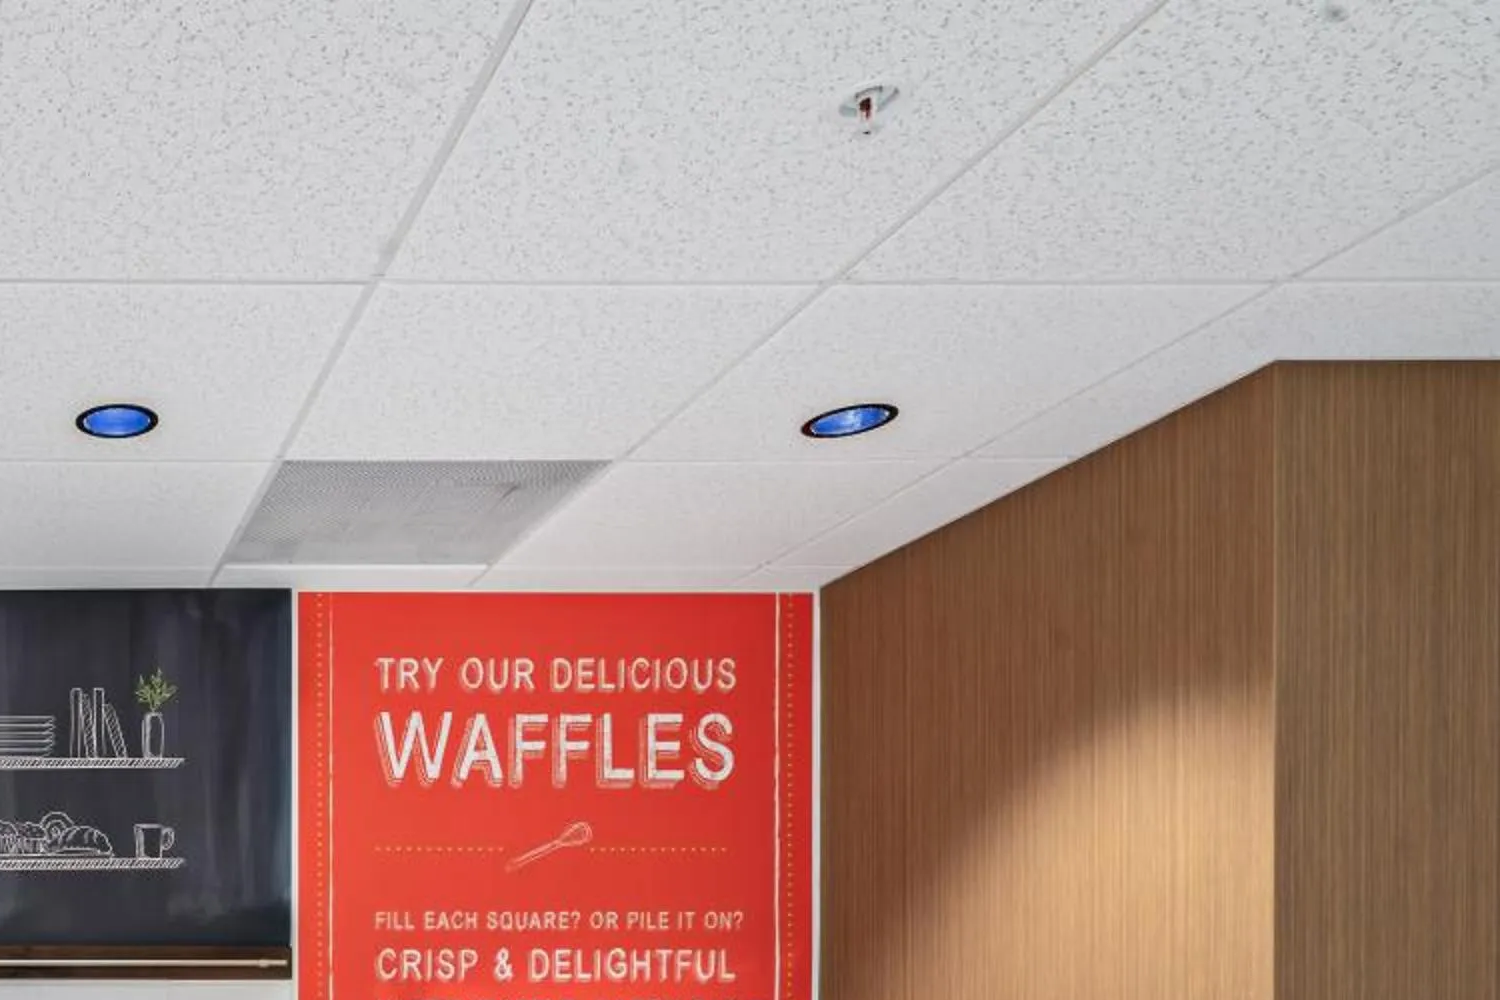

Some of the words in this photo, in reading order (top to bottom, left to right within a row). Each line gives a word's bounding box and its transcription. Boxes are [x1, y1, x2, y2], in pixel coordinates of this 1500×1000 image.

[374, 657, 444, 693] TRY
[459, 657, 535, 693] OUR
[551, 657, 737, 693] DELICIOUS
[374, 711, 736, 789] WAFFLES
[375, 911, 415, 930] FILL
[424, 911, 478, 930] EACH
[486, 911, 581, 931] SQUARE?
[590, 911, 619, 930] OR
[626, 911, 669, 930] PILE
[677, 911, 696, 930] IT
[704, 911, 744, 930] ON?
[375, 948, 479, 983] CRISP
[493, 947, 513, 982] &
[528, 948, 736, 983] DELIGHTFUL
